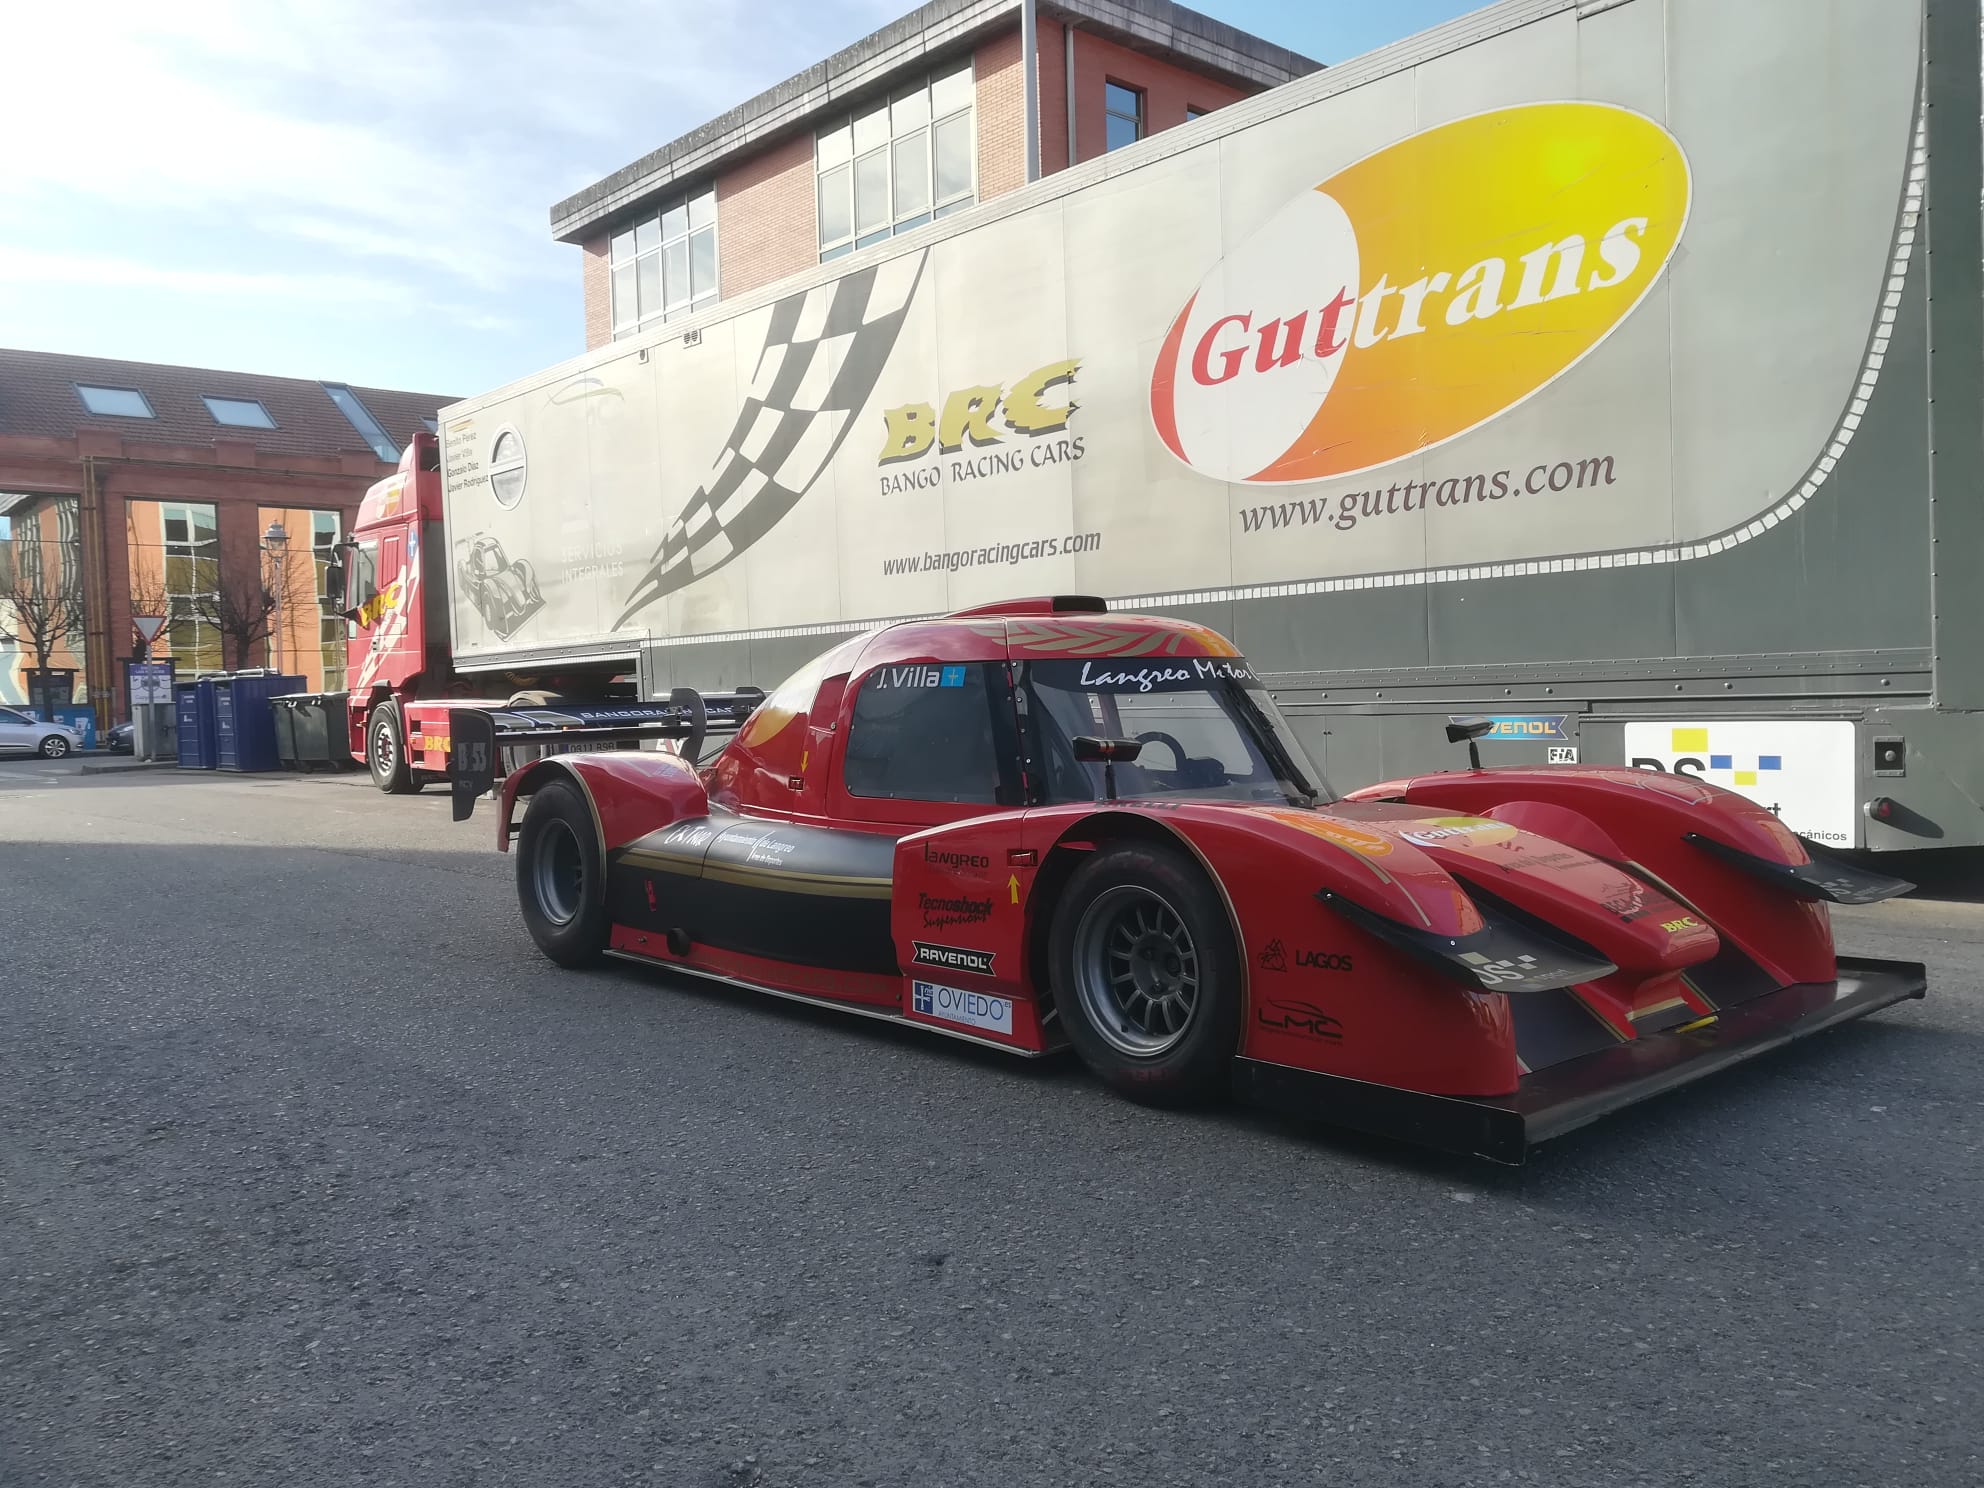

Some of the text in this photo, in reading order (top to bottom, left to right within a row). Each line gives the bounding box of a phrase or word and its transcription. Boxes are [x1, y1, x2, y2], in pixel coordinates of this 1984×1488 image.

[1190, 216, 1649, 386] Guttrans
[877, 357, 1085, 467] BRC
[880, 436, 1085, 496] BANGO RACING CARS
[1238, 454, 1617, 534] www.guttrans.com
[883, 531, 1101, 576] www.bangoracingcars.com
[561, 560, 624, 584] INTEGRALES
[361, 582, 400, 628] BRC
[1080, 661, 1190, 692] Langreo
[1490, 721, 1557, 735] VENOL
[918, 892, 993, 915] Tecnoshock
[1660, 916, 1698, 933] BRC
[920, 947, 987, 969] RAVENOL
[1296, 949, 1353, 972] LAGOS
[938, 987, 1004, 1021] OVIEDO
[1258, 1007, 1343, 1039] LMC
